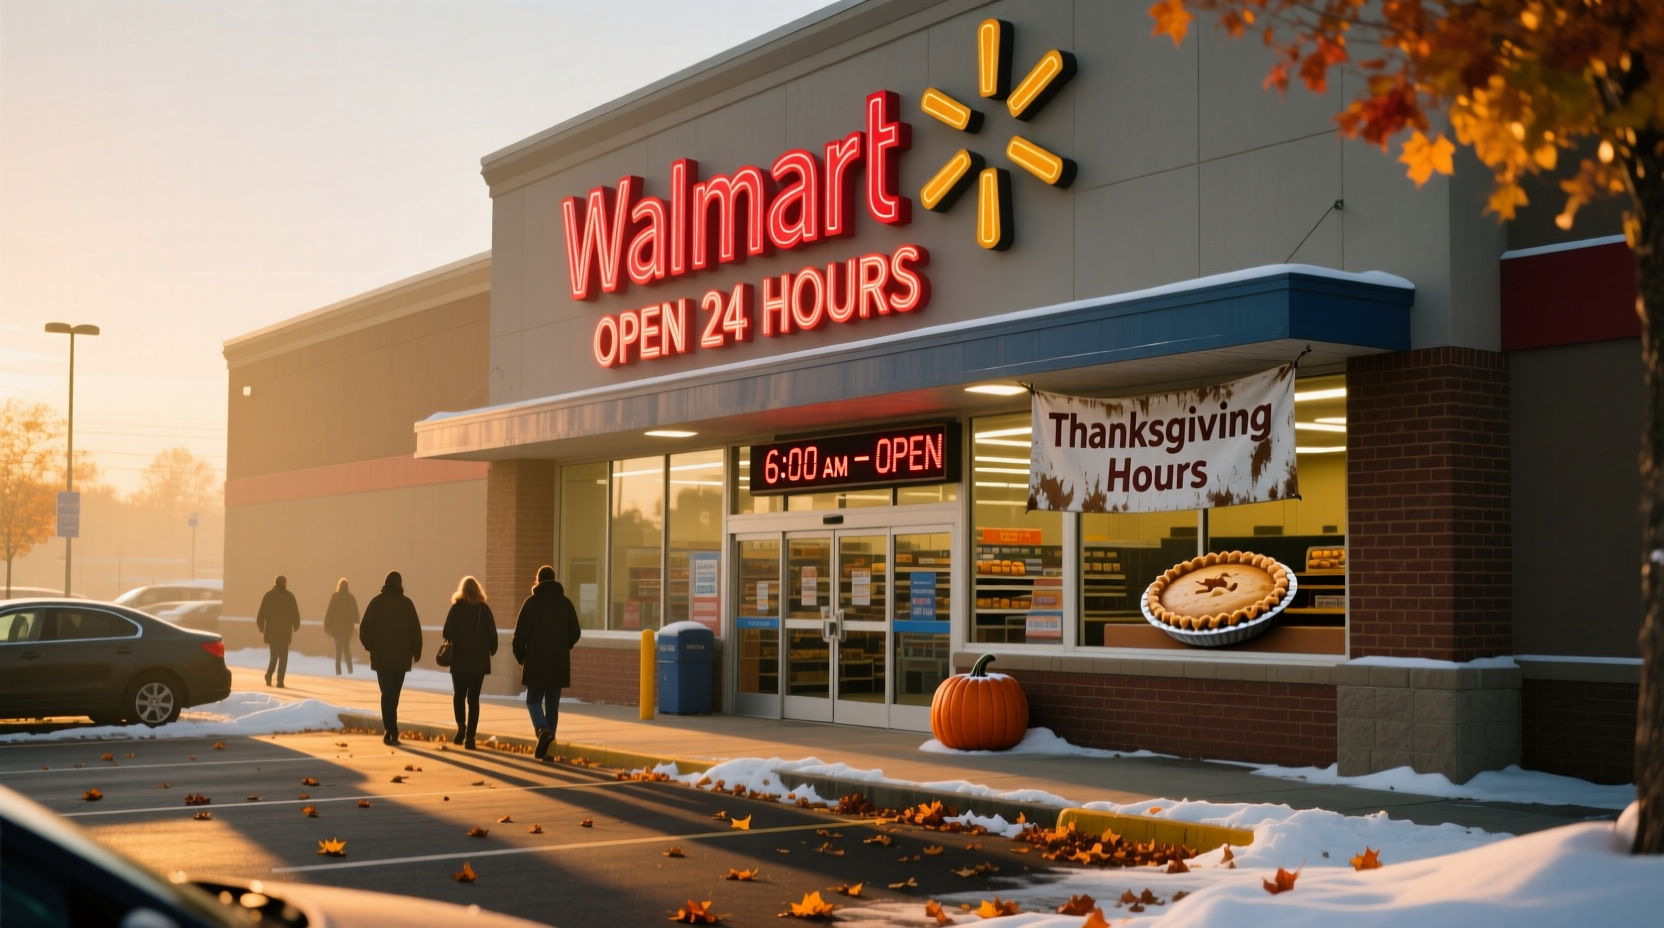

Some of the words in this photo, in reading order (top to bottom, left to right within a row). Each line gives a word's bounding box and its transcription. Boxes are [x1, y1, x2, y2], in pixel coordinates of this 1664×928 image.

[561, 89, 908, 301] Walmart
[593, 297, 690, 368] OPEN
[700, 282, 751, 348] 24
[761, 243, 928, 337] HOURS
[1048, 400, 1272, 455] Thanksgiving
[764, 446, 818, 485] 6:00
[822, 455, 848, 478] AM
[875, 433, 943, 474] OPEN
[1106, 457, 1208, 493] Hours
